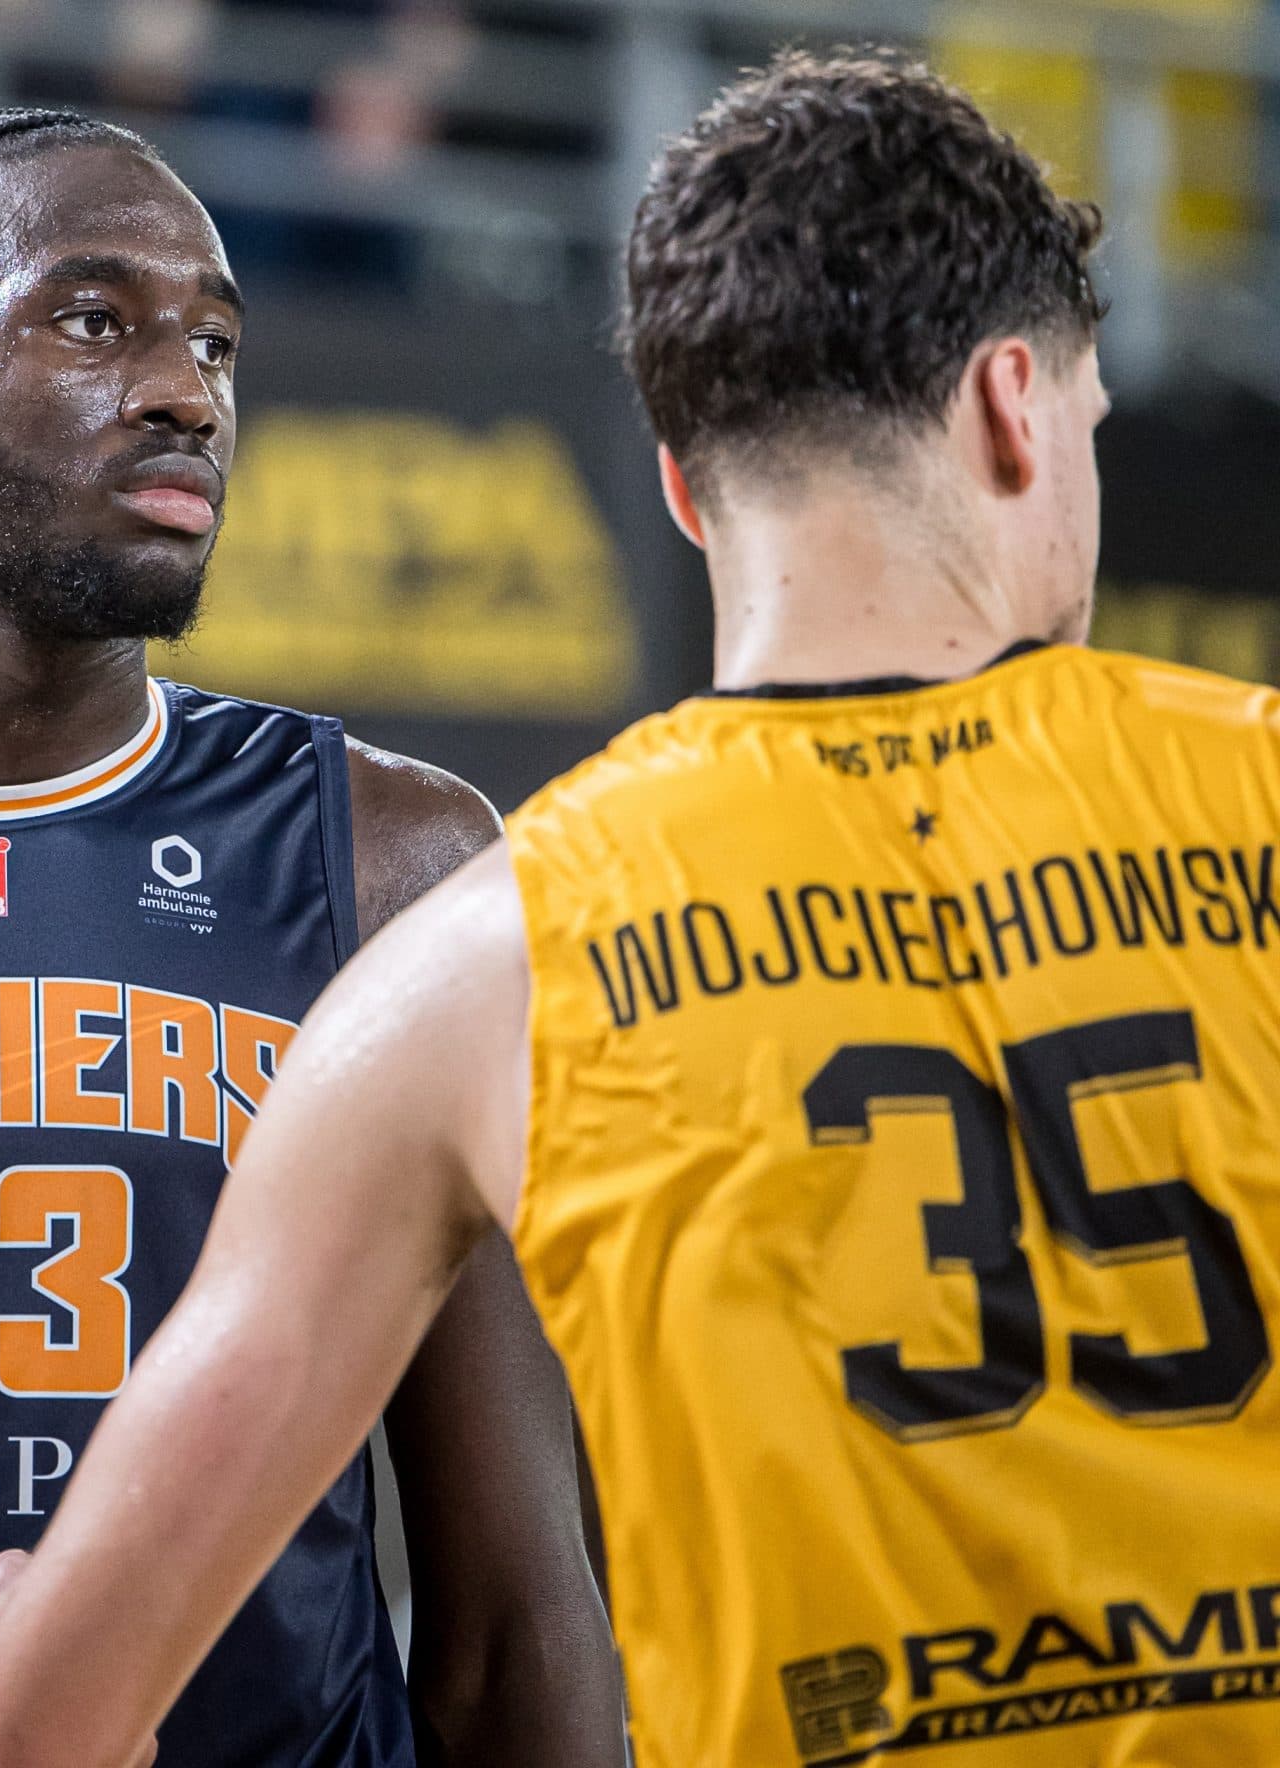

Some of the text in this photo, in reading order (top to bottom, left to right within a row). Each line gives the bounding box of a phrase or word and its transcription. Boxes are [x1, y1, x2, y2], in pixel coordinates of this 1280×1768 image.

[137, 896, 219, 920] ambulance
[142, 881, 212, 906] Harmonie
[189, 922, 214, 935] vyv
[588, 843, 1280, 1030] WOJCIECHOWSK
[801, 1006, 1272, 1446] 35
[923, 1678, 1176, 1741] TRAVAUX
